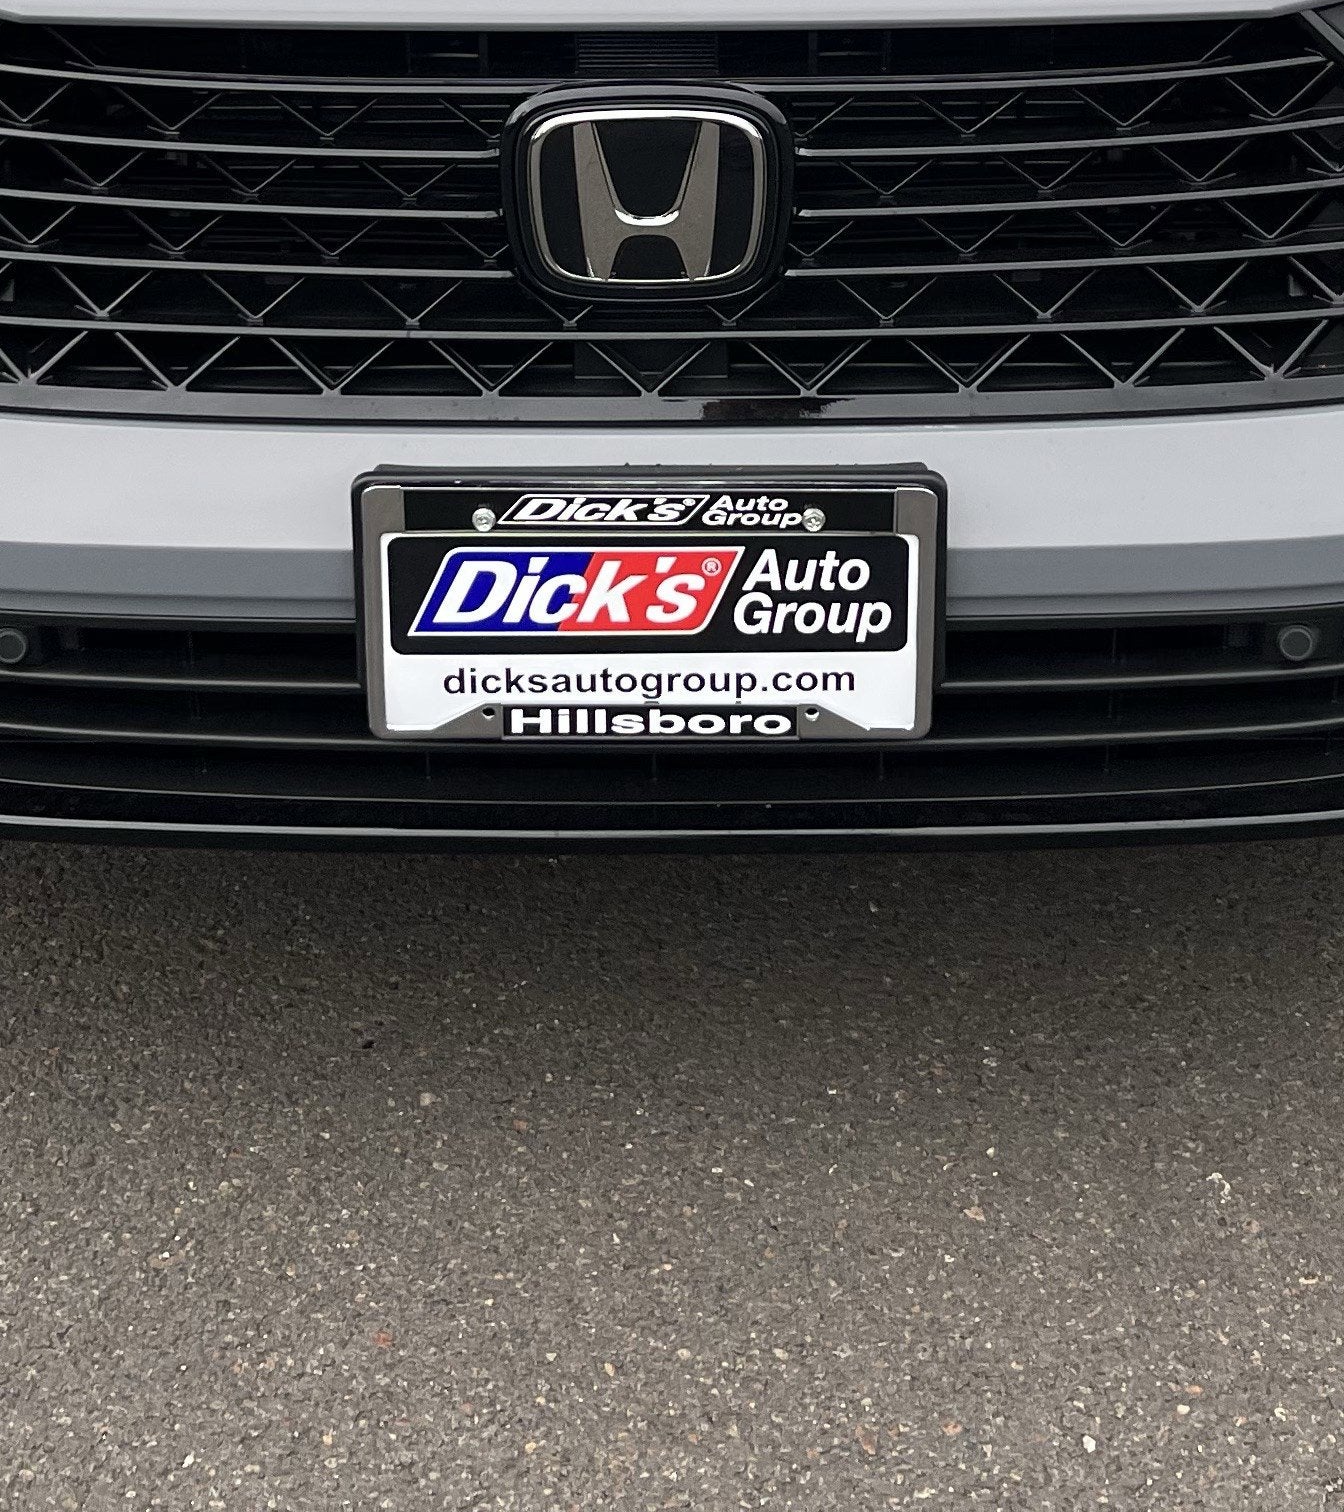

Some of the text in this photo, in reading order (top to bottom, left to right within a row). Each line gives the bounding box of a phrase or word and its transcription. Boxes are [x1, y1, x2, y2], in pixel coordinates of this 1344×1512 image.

[709, 494, 789, 511] Auto
[701, 509, 803, 529] Group
[741, 548, 871, 591] Auto
[733, 591, 892, 643] Group
[443, 667, 856, 699] dicksautogroup.com
[510, 708, 793, 735] Hillsboro
